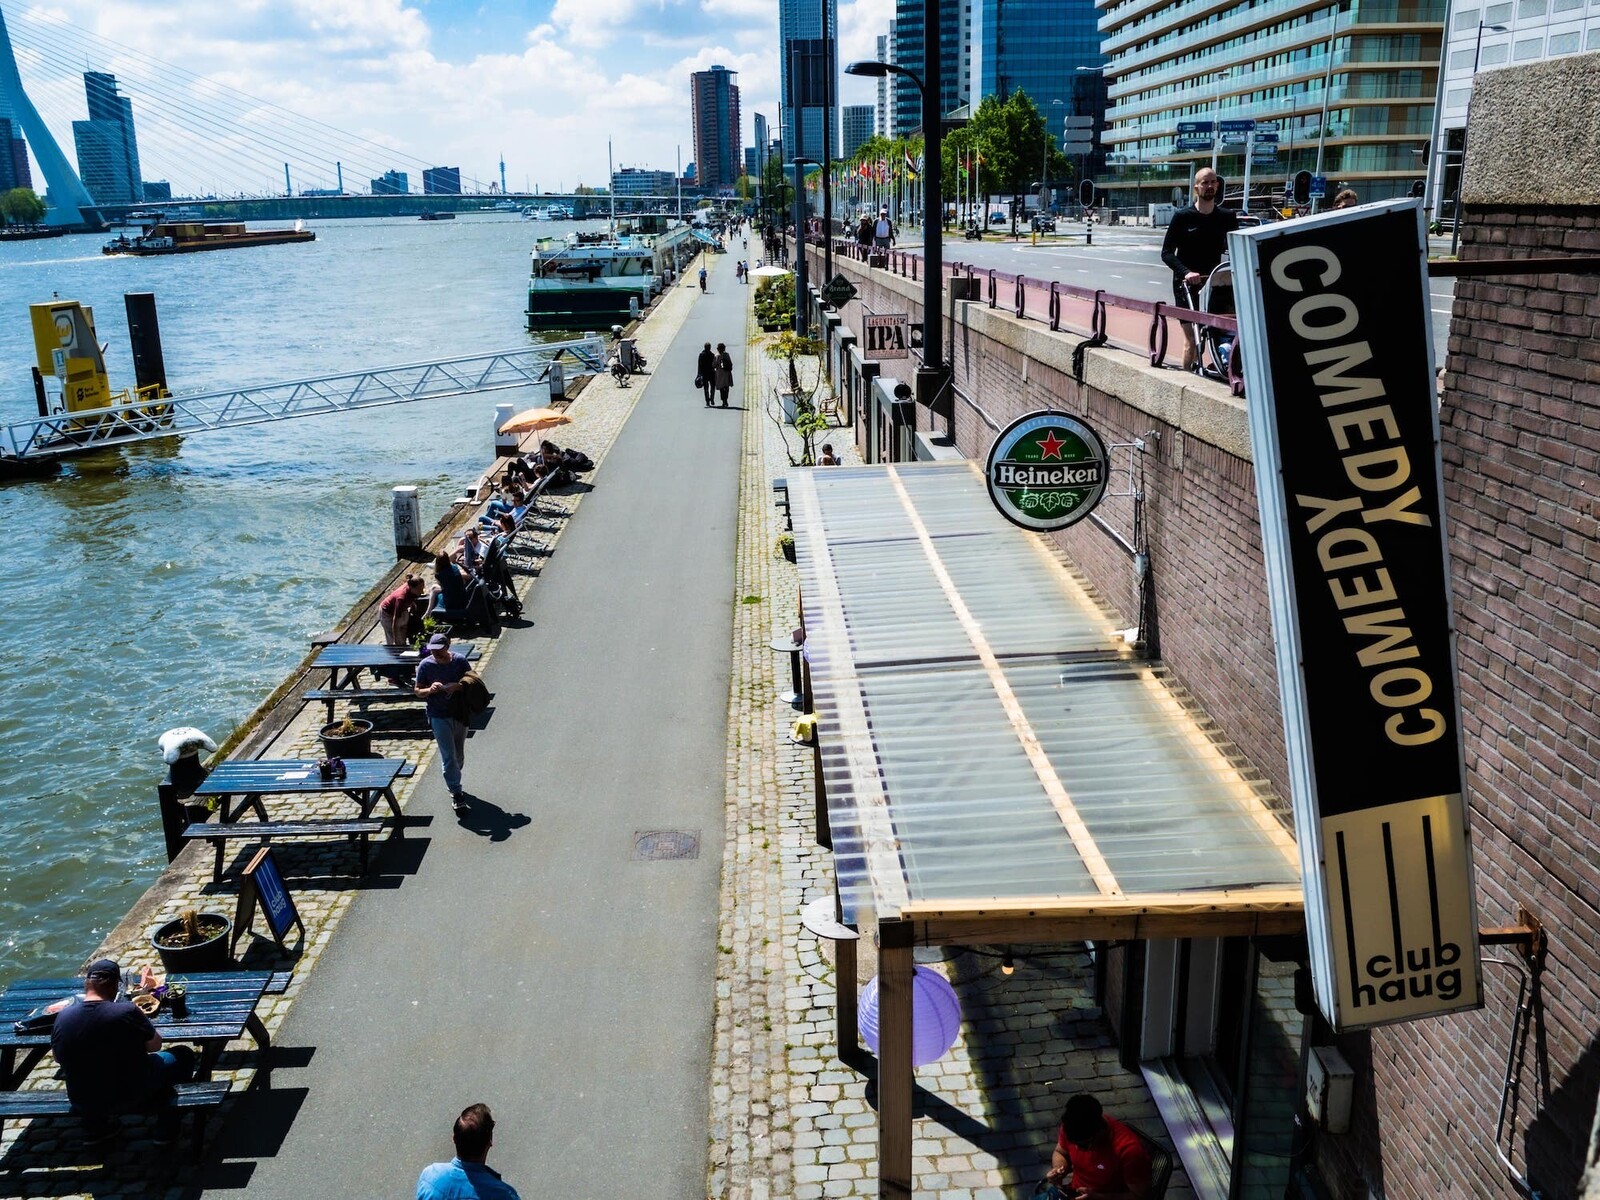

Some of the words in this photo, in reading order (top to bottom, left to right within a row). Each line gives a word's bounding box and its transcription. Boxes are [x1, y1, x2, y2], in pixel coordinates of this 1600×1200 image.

[867, 326, 906, 351] IPA
[1271, 245, 1432, 527] COMEDY
[999, 466, 1098, 485] Heineken
[399, 515, 412, 524] 62
[1295, 493, 1446, 746] COMEDY
